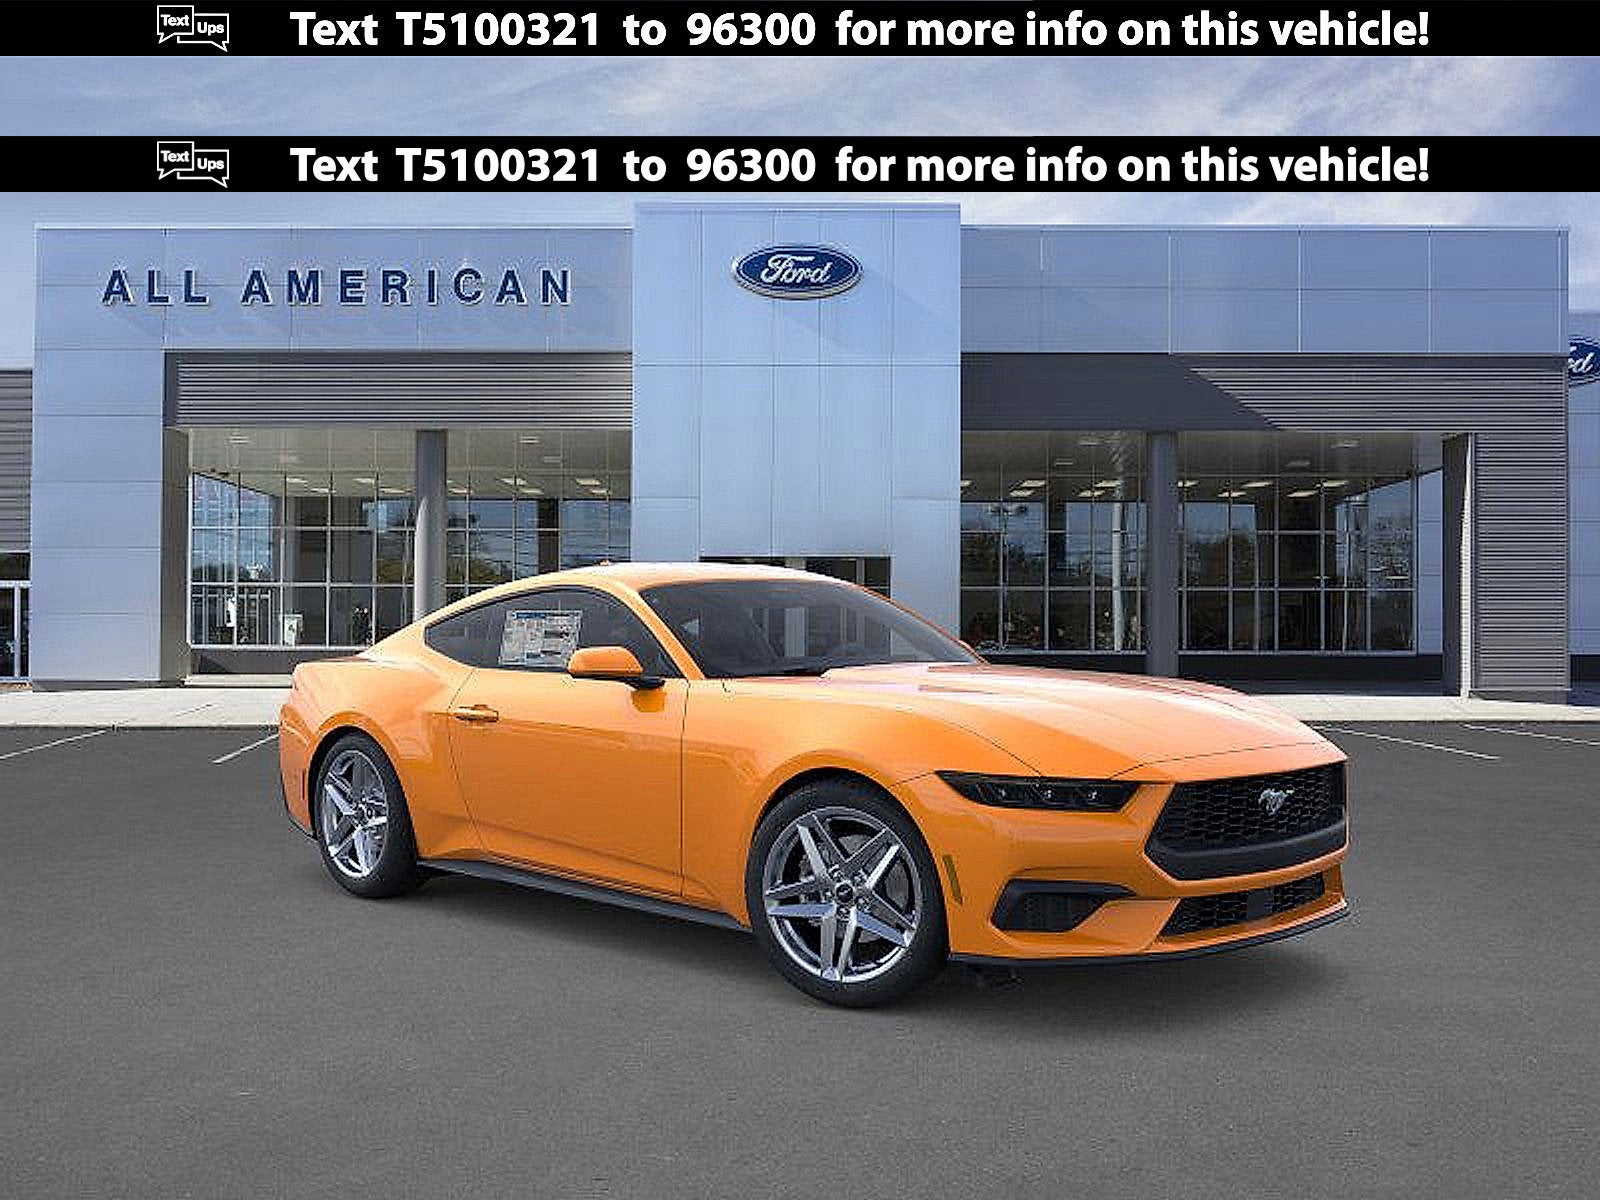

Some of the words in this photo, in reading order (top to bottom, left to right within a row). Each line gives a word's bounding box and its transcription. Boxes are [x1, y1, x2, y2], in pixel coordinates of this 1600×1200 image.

[760, 253, 833, 284] Ford
[102, 269, 210, 305] ALL
[240, 268, 573, 306] AMERICAN
